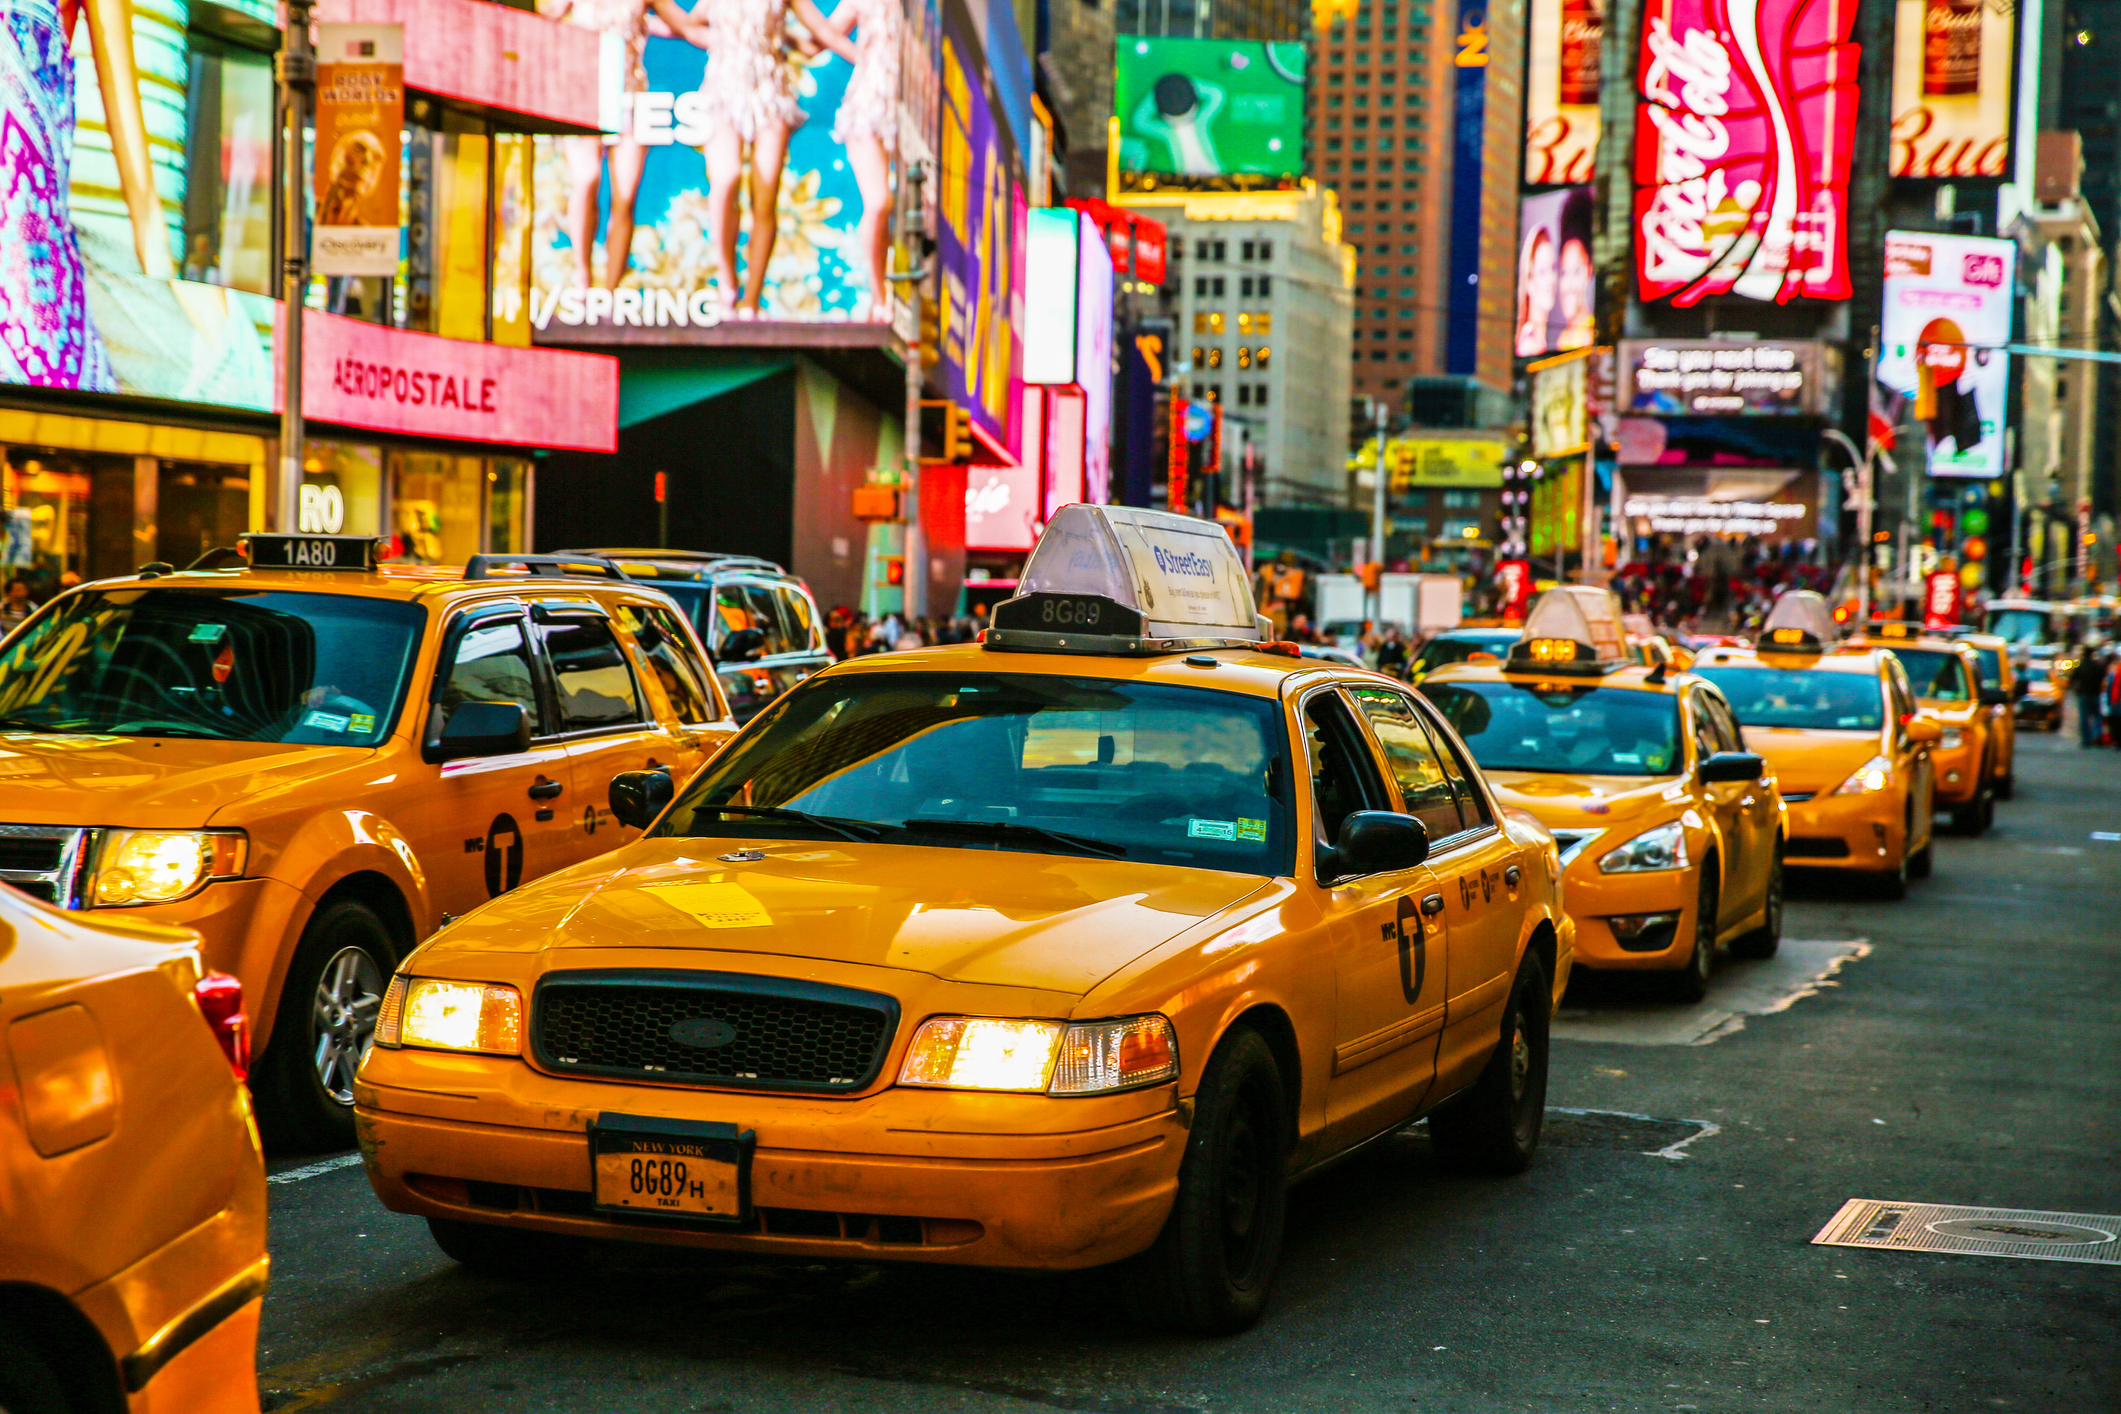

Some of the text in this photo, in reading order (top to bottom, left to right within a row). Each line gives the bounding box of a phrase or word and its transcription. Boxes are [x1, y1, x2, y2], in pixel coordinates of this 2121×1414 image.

[284, 540, 336, 566] 1A80
[1164, 548, 1215, 585] StreetEasy
[1042, 600, 1100, 625] 8G89
[1381, 922, 1397, 942] NYC
[633, 1142, 704, 1156] NEW YORK
[657, 1198, 680, 1208] TAXI
